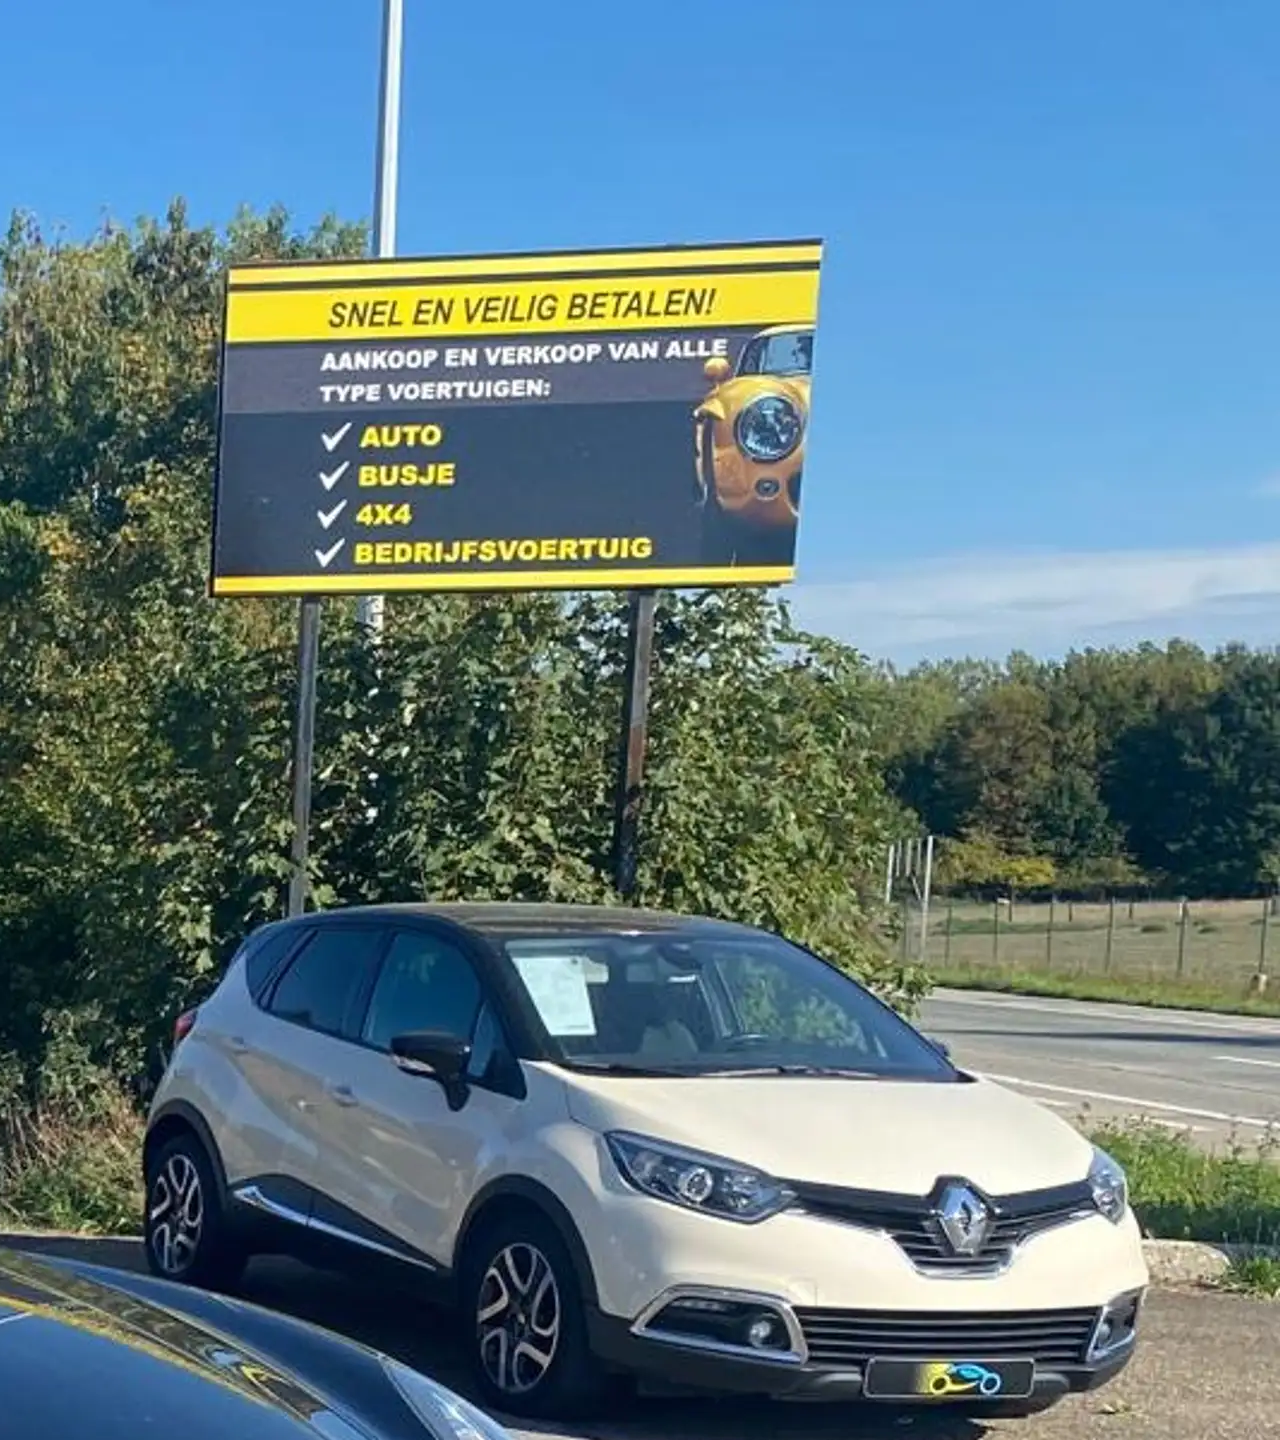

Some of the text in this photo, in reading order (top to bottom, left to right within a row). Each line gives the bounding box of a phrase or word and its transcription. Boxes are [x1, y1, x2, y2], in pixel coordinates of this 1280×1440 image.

[328, 288, 716, 328] SNEL EN VEILIG BETALEN!
[319, 338, 729, 372] AANKOOP EN VERKOOP VAN ALLE
[318, 378, 552, 403] TYPE VOERTUIGEN:
[359, 424, 442, 448] AUTO
[357, 463, 456, 487] BUSJE
[355, 503, 413, 526] 4X4
[353, 537, 653, 565] BEDRIJFSVOERTUIG
